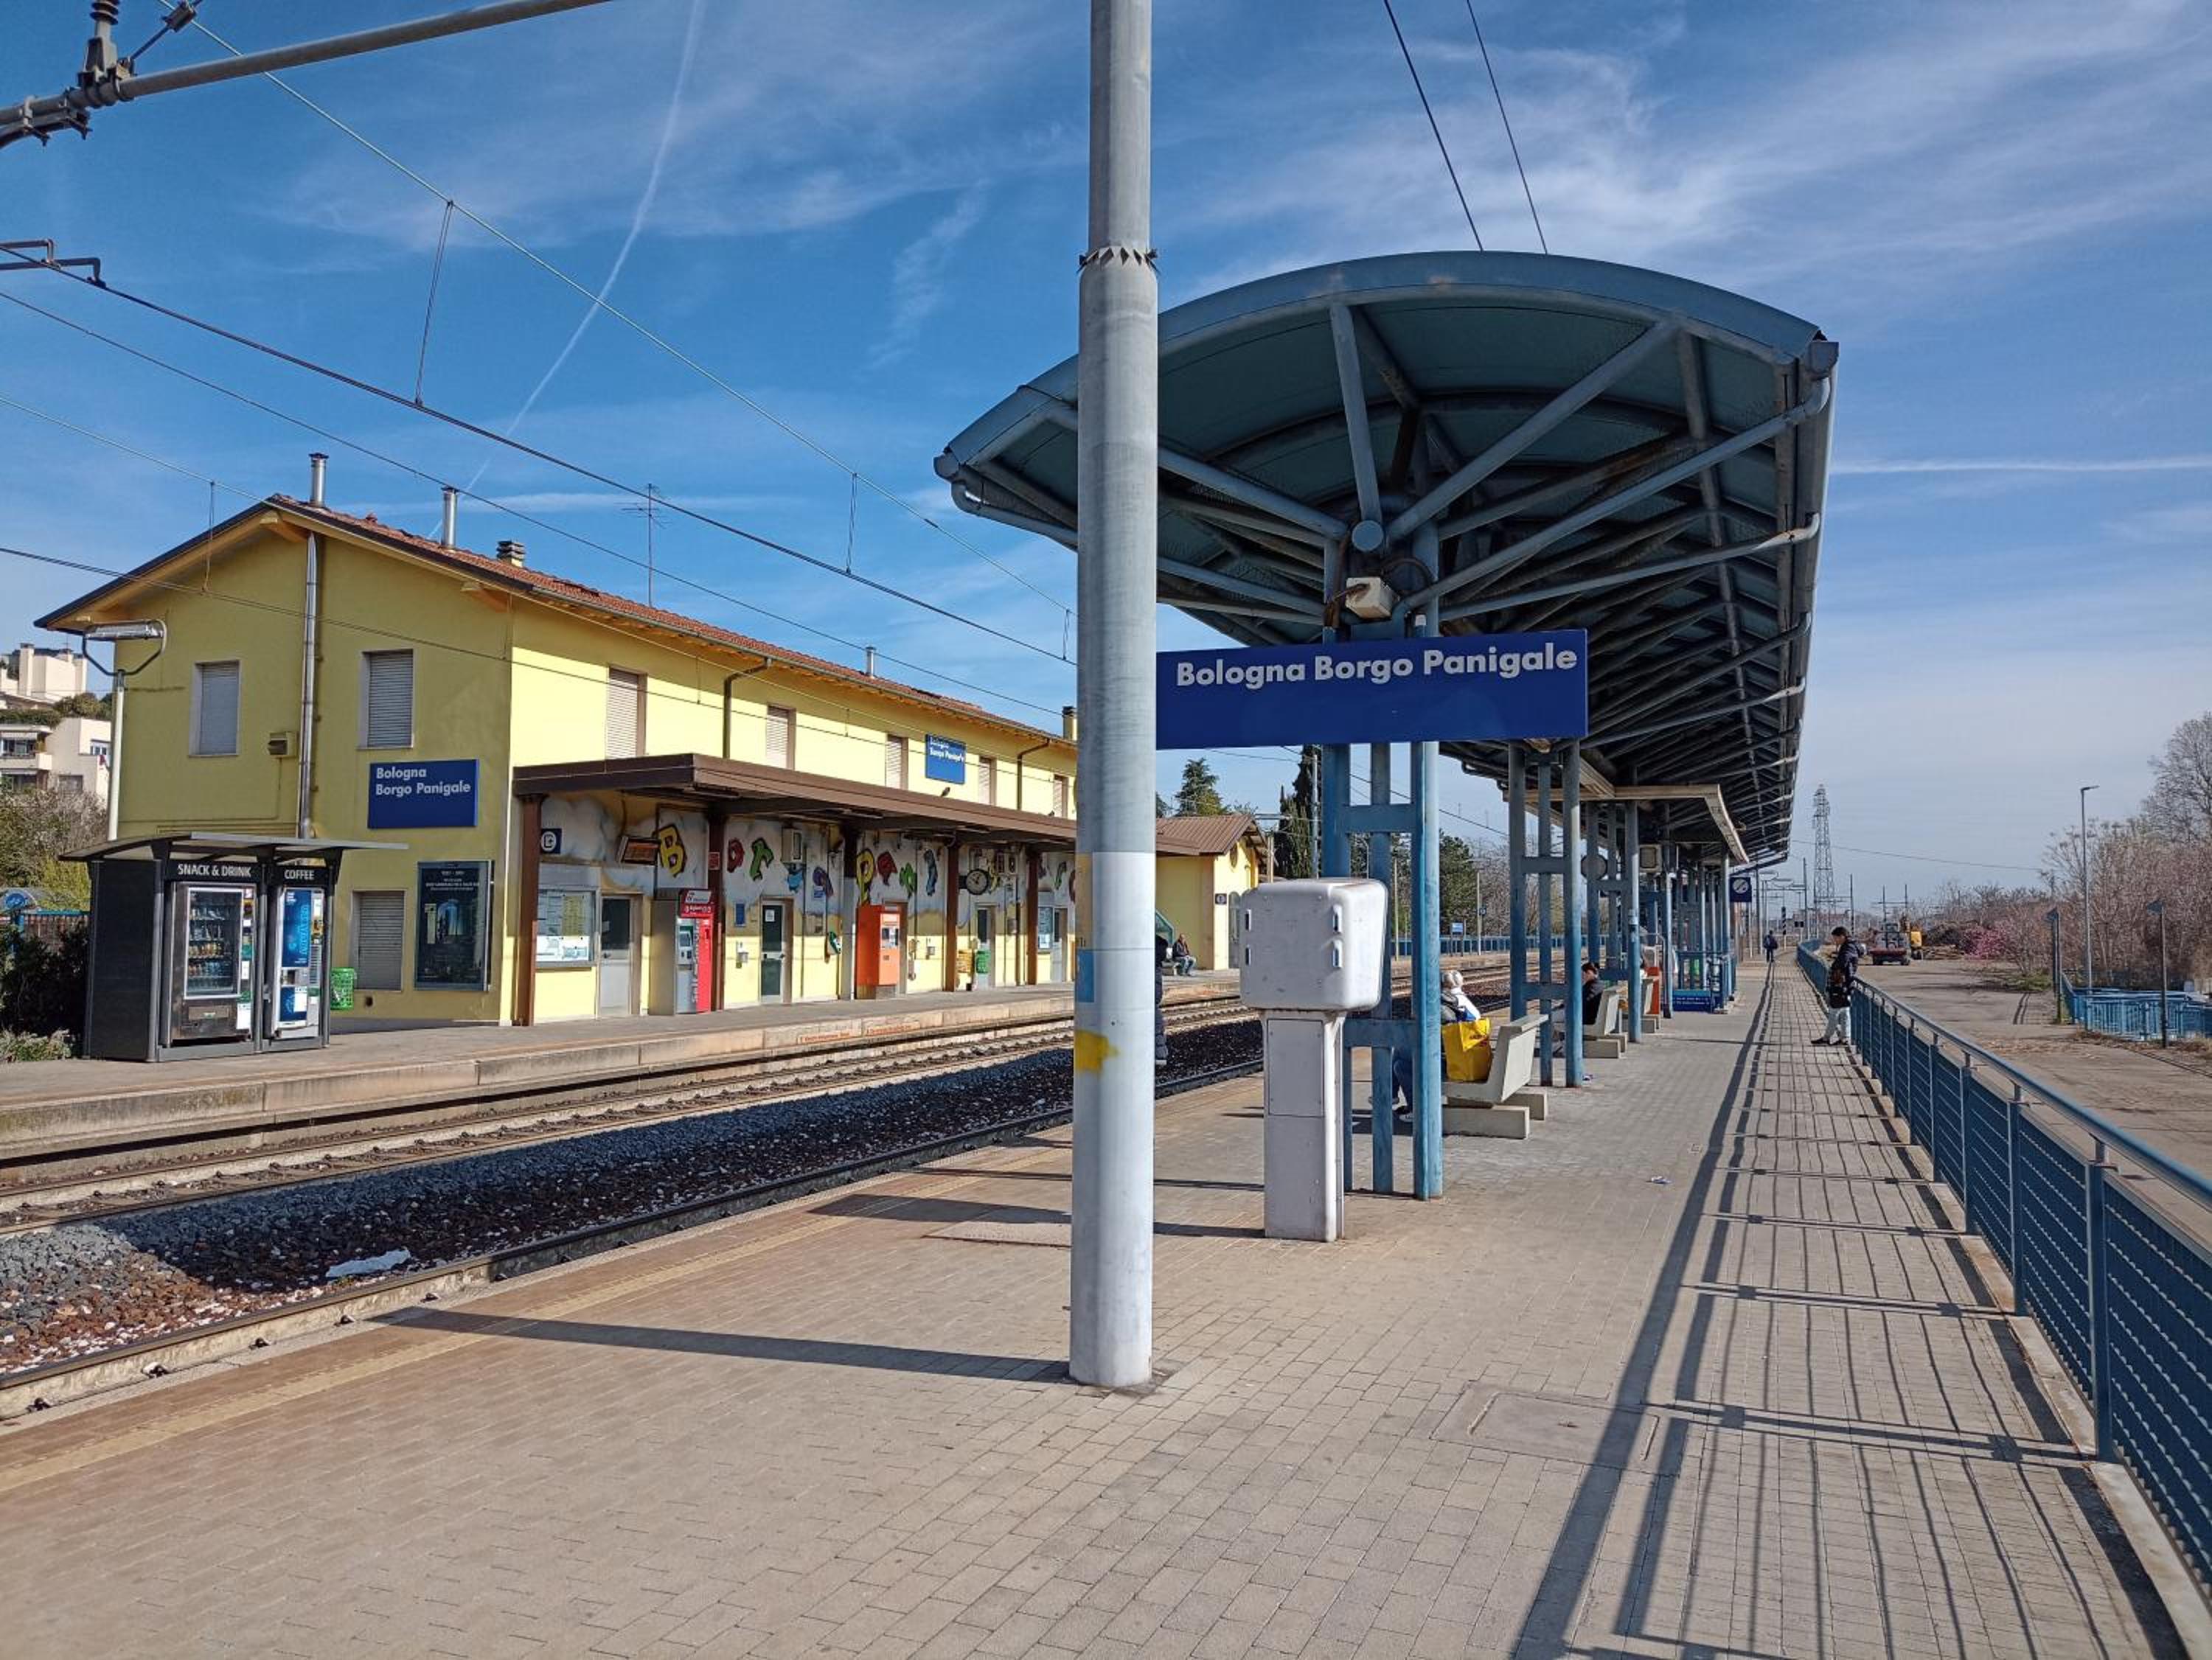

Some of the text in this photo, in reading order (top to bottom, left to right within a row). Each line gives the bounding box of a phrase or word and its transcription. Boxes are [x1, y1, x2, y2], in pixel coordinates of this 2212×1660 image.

[1177, 642, 1578, 690] Bologna Borgo Panigale
[376, 767, 427, 781] Bologna
[375, 780, 471, 798] Borgo Panigale
[178, 863, 251, 878] SNACK & DRINK
[284, 869, 315, 880] COFFEE
